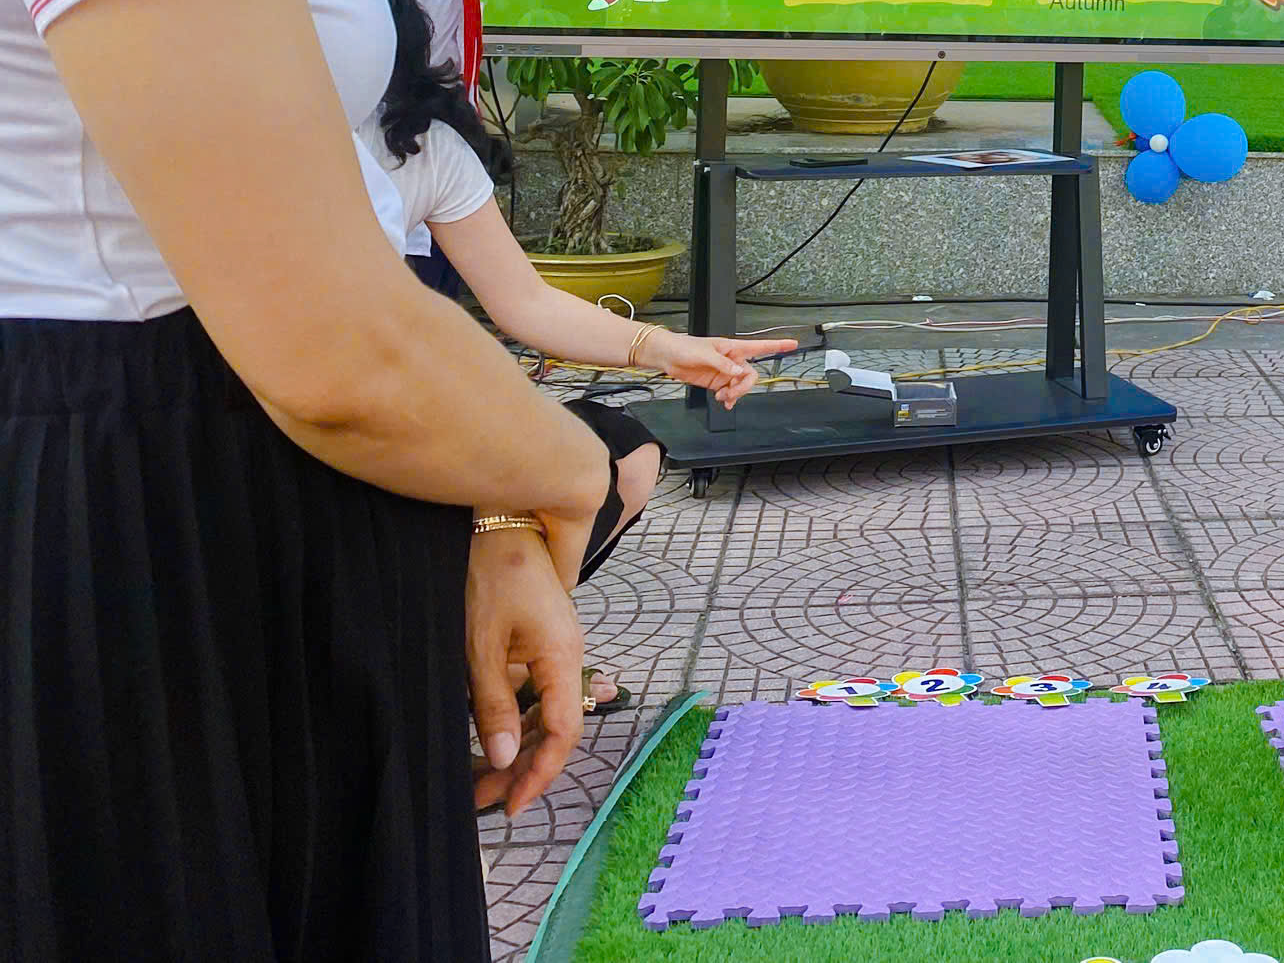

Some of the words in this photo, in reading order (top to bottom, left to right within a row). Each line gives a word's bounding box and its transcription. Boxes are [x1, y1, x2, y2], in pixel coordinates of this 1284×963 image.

[920, 678, 951, 693] 2
[1029, 682, 1058, 692] 3
[1146, 682, 1172, 690] 4
[837, 686, 858, 695] 1
